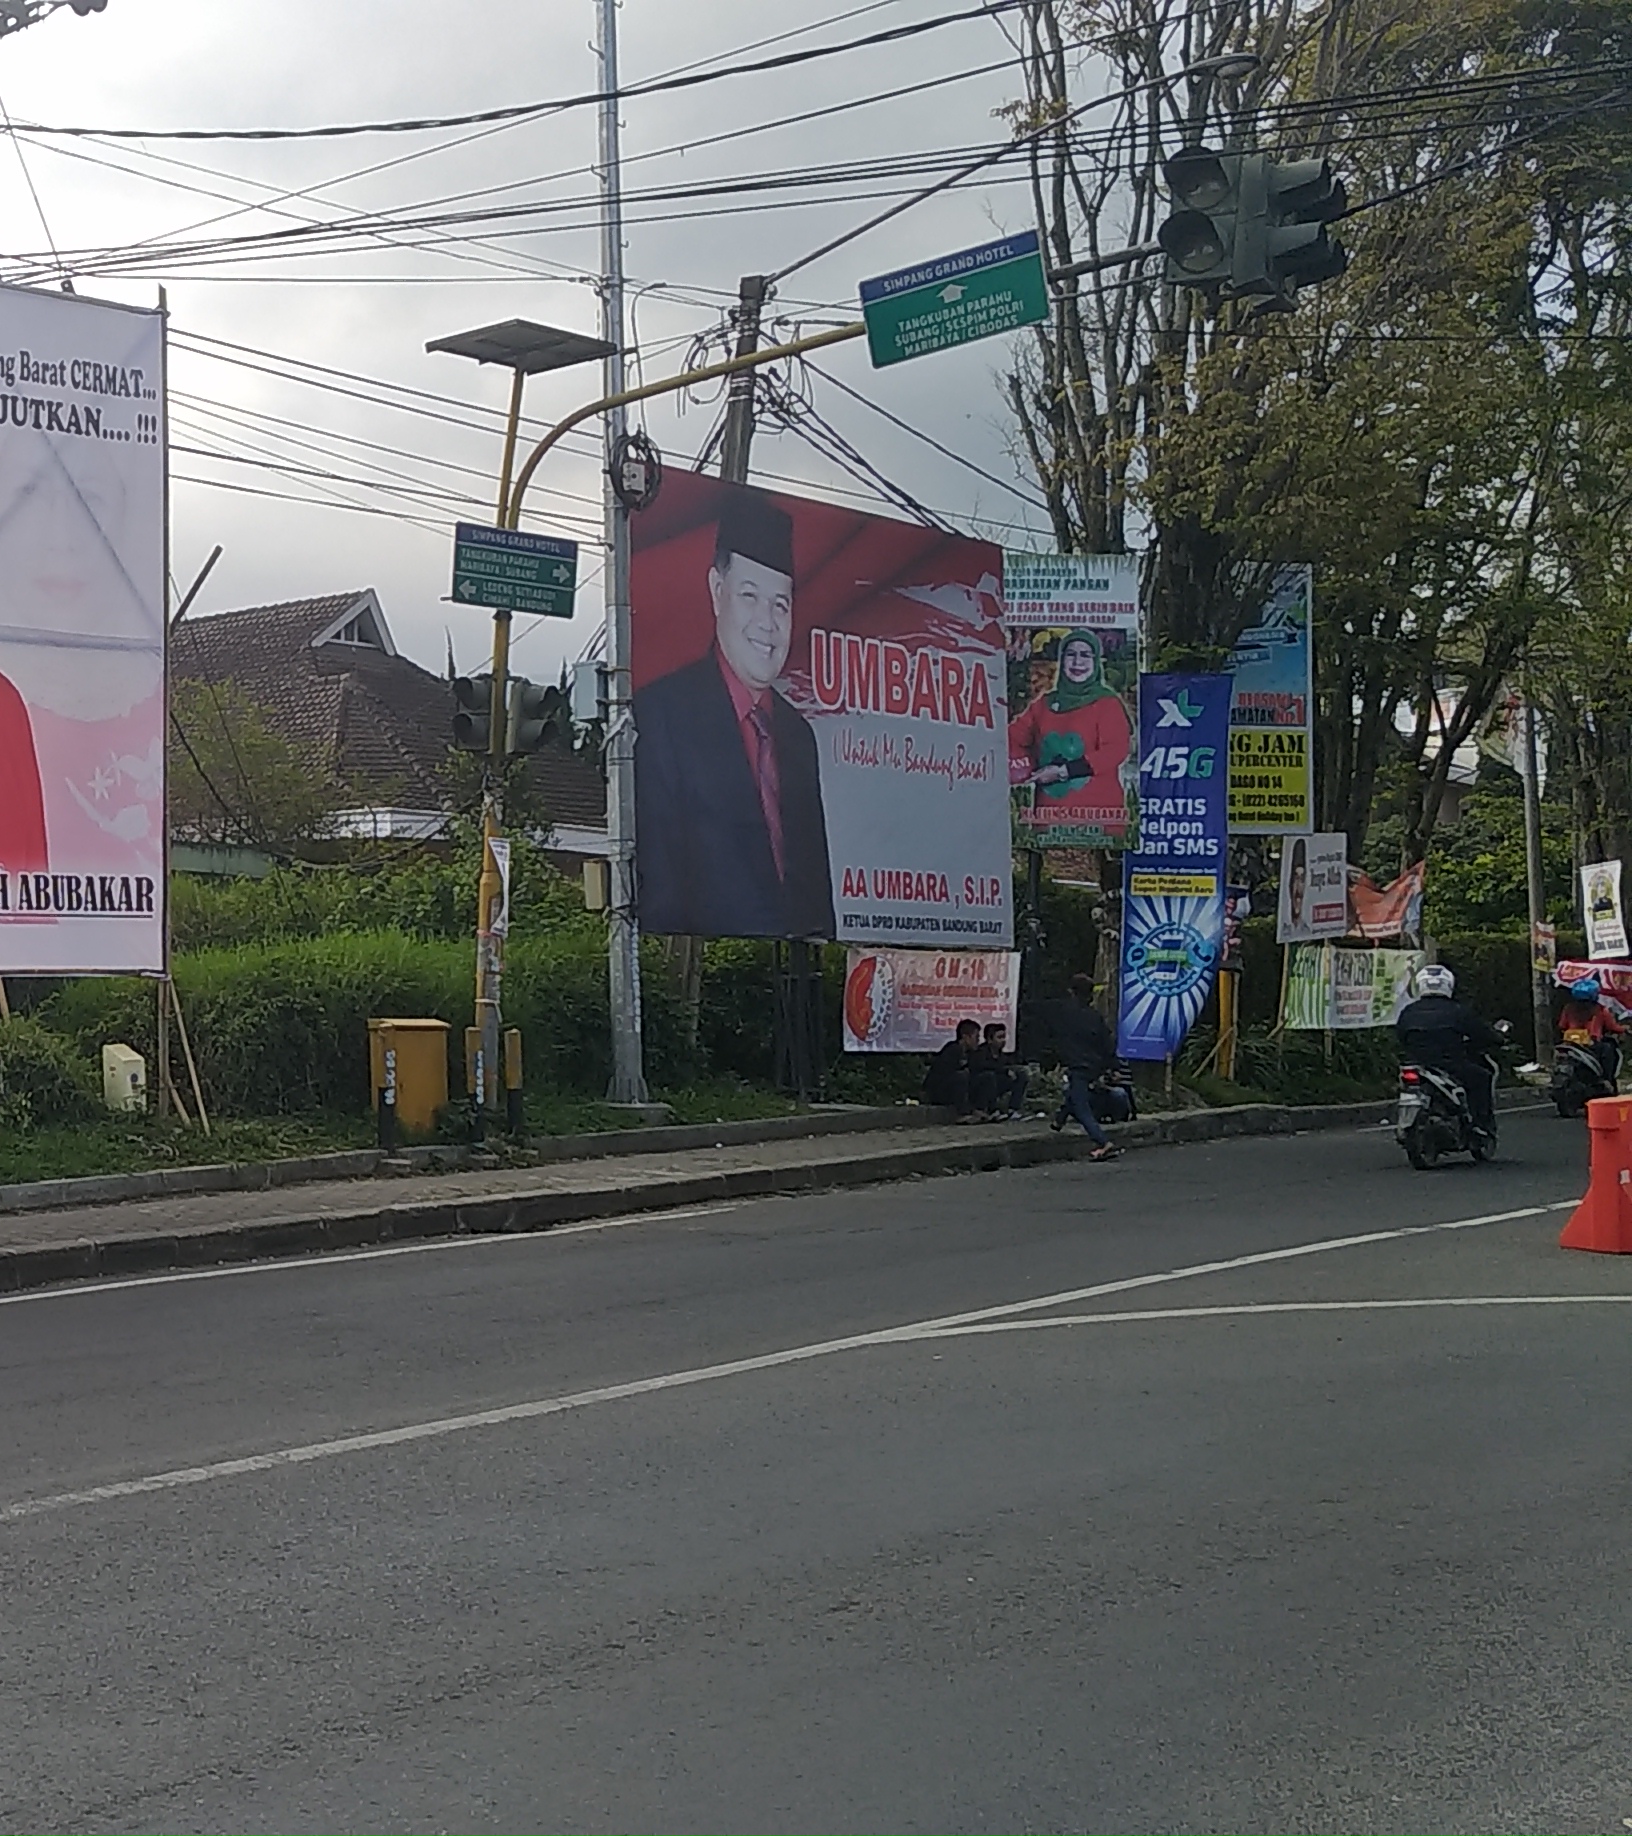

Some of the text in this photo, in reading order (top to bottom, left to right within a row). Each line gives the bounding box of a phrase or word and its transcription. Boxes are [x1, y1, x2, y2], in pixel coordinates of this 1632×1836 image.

[884, 244, 1014, 292] SIMPANG GRAND HOTEL
[898, 291, 1012, 333] TANGKUBAN PARAHU
[990, 300, 1024, 318] POLRI
[904, 331, 960, 356] MARIBAYA
[968, 315, 1018, 338] CIBODAS
[19, 350, 67, 387] Barat
[70, 359, 157, 400] CERMAT...
[811, 628, 995, 730] UMBARA
[1230, 754, 1303, 768] UPERCENTER
[1257, 734, 1305, 754] JAM
[1173, 838, 1219, 856] SMS
[17, 873, 154, 913] ABUBAKAR
[842, 867, 869, 898] AA
[843, 914, 870, 928] KETUA
[895, 916, 941, 932] KABUPATEN
[942, 918, 978, 933] BANDUNG
[979, 920, 1003, 934] BARAT
